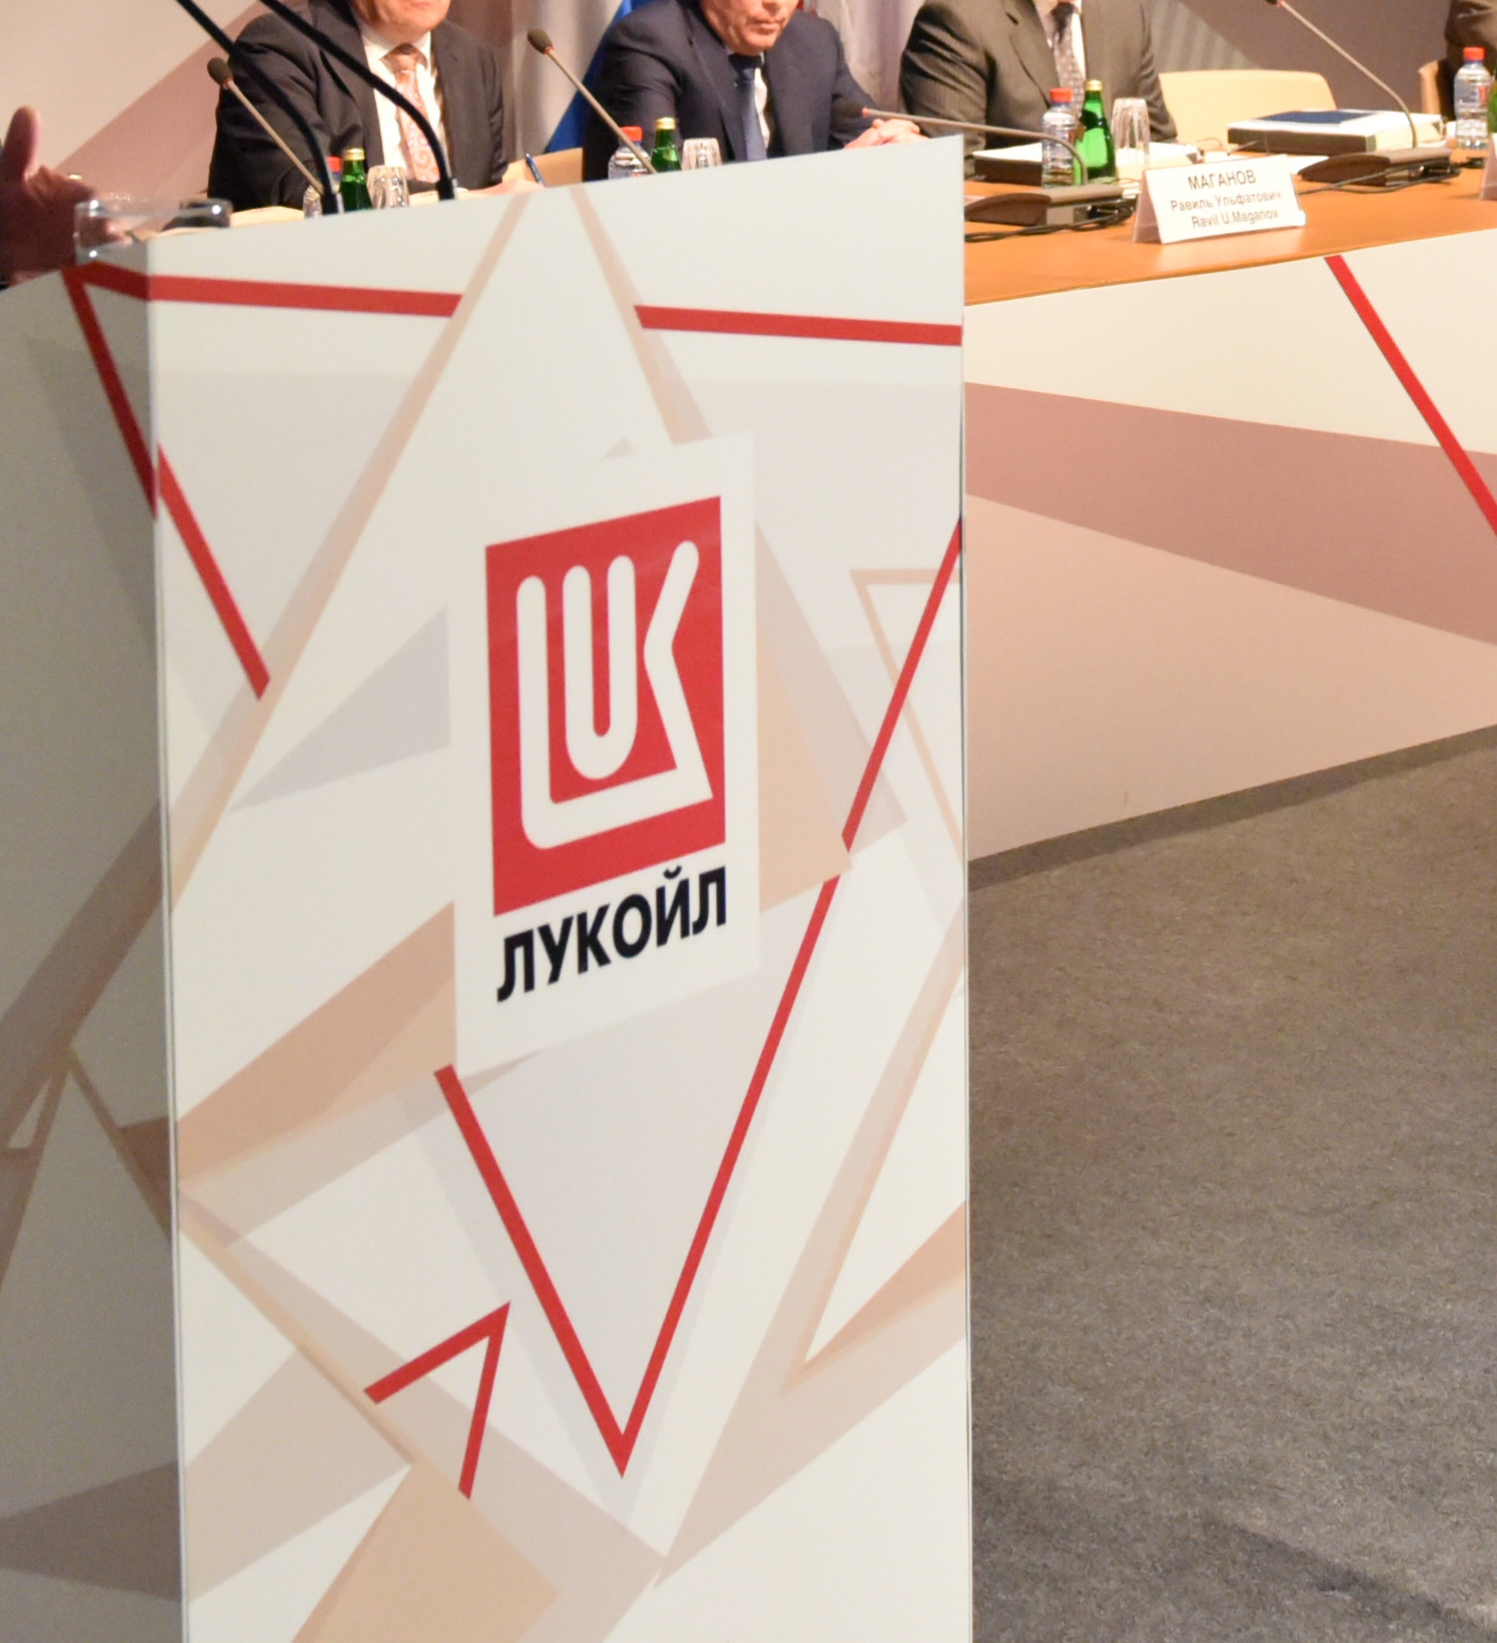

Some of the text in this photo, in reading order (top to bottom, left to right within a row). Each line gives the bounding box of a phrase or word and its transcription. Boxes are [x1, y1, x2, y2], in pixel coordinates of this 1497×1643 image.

[1187, 169, 1257, 190] МАГАНОВ
[1170, 191, 1282, 212] Равиль Ульфатович
[1191, 210, 1279, 228] Ravil U.Maganov
[497, 865, 727, 1003] ЛУКОЙЛ
